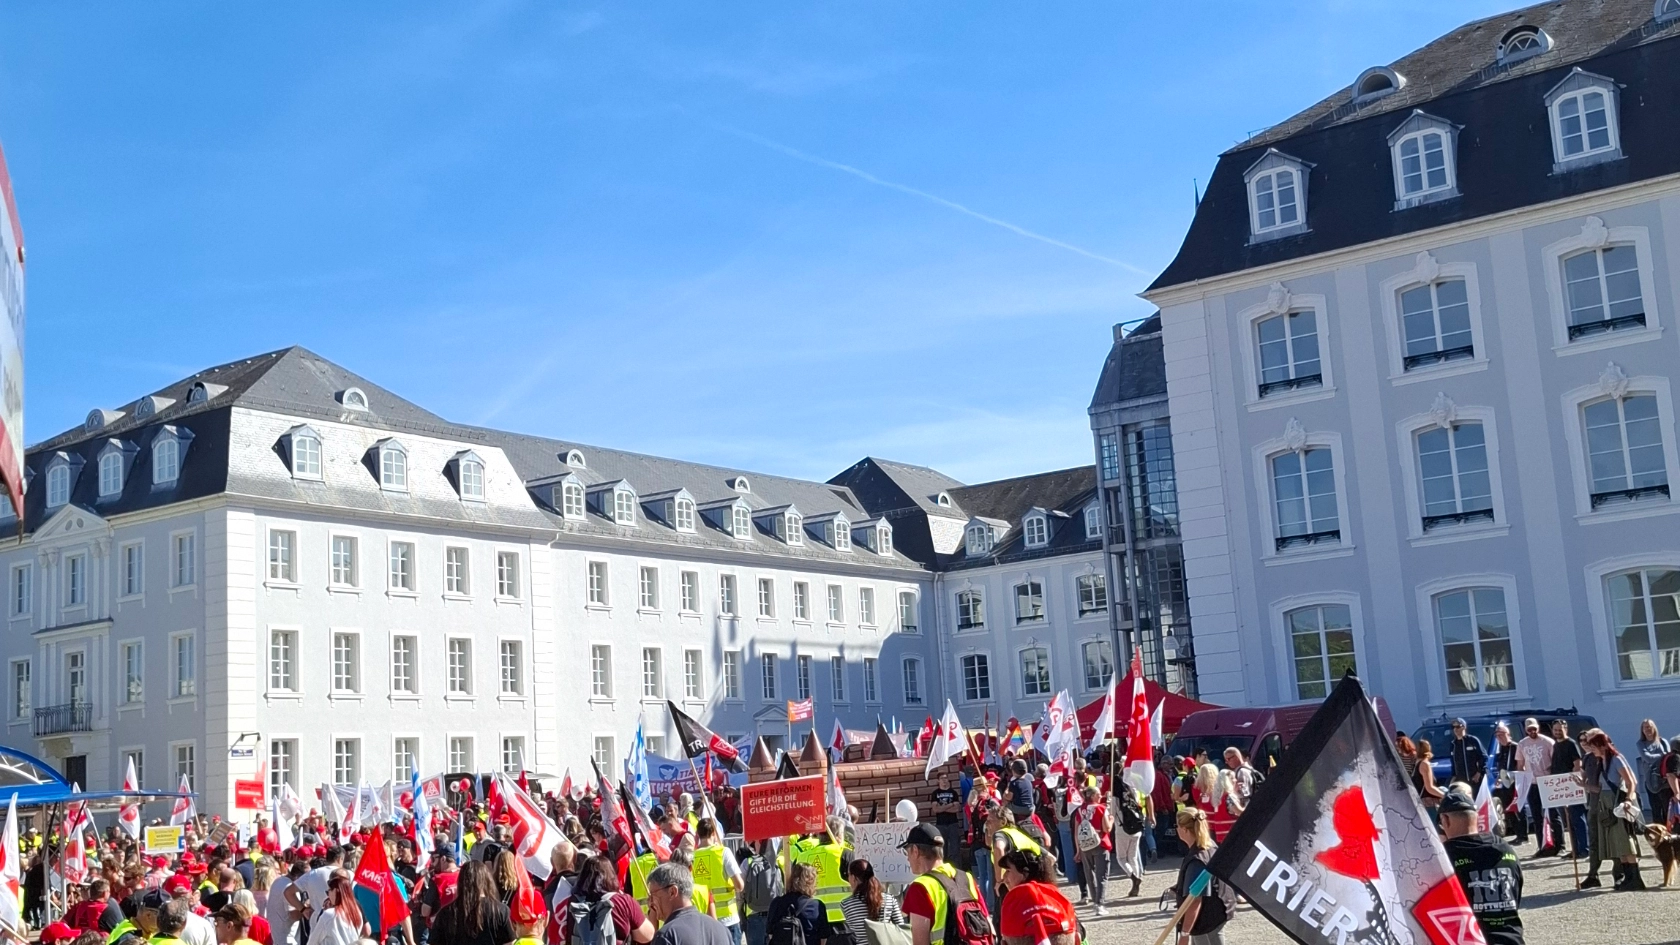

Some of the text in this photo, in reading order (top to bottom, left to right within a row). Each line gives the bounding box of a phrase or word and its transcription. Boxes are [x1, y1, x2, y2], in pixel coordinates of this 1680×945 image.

[688, 740, 707, 753] TR
[749, 784, 815, 798] EURE REFORMEN:
[749, 793, 797, 806] GIFT FÜR DIE
[749, 799, 816, 814] GLEICHSTELLUNG.
[1246, 840, 1359, 945] TRIER
